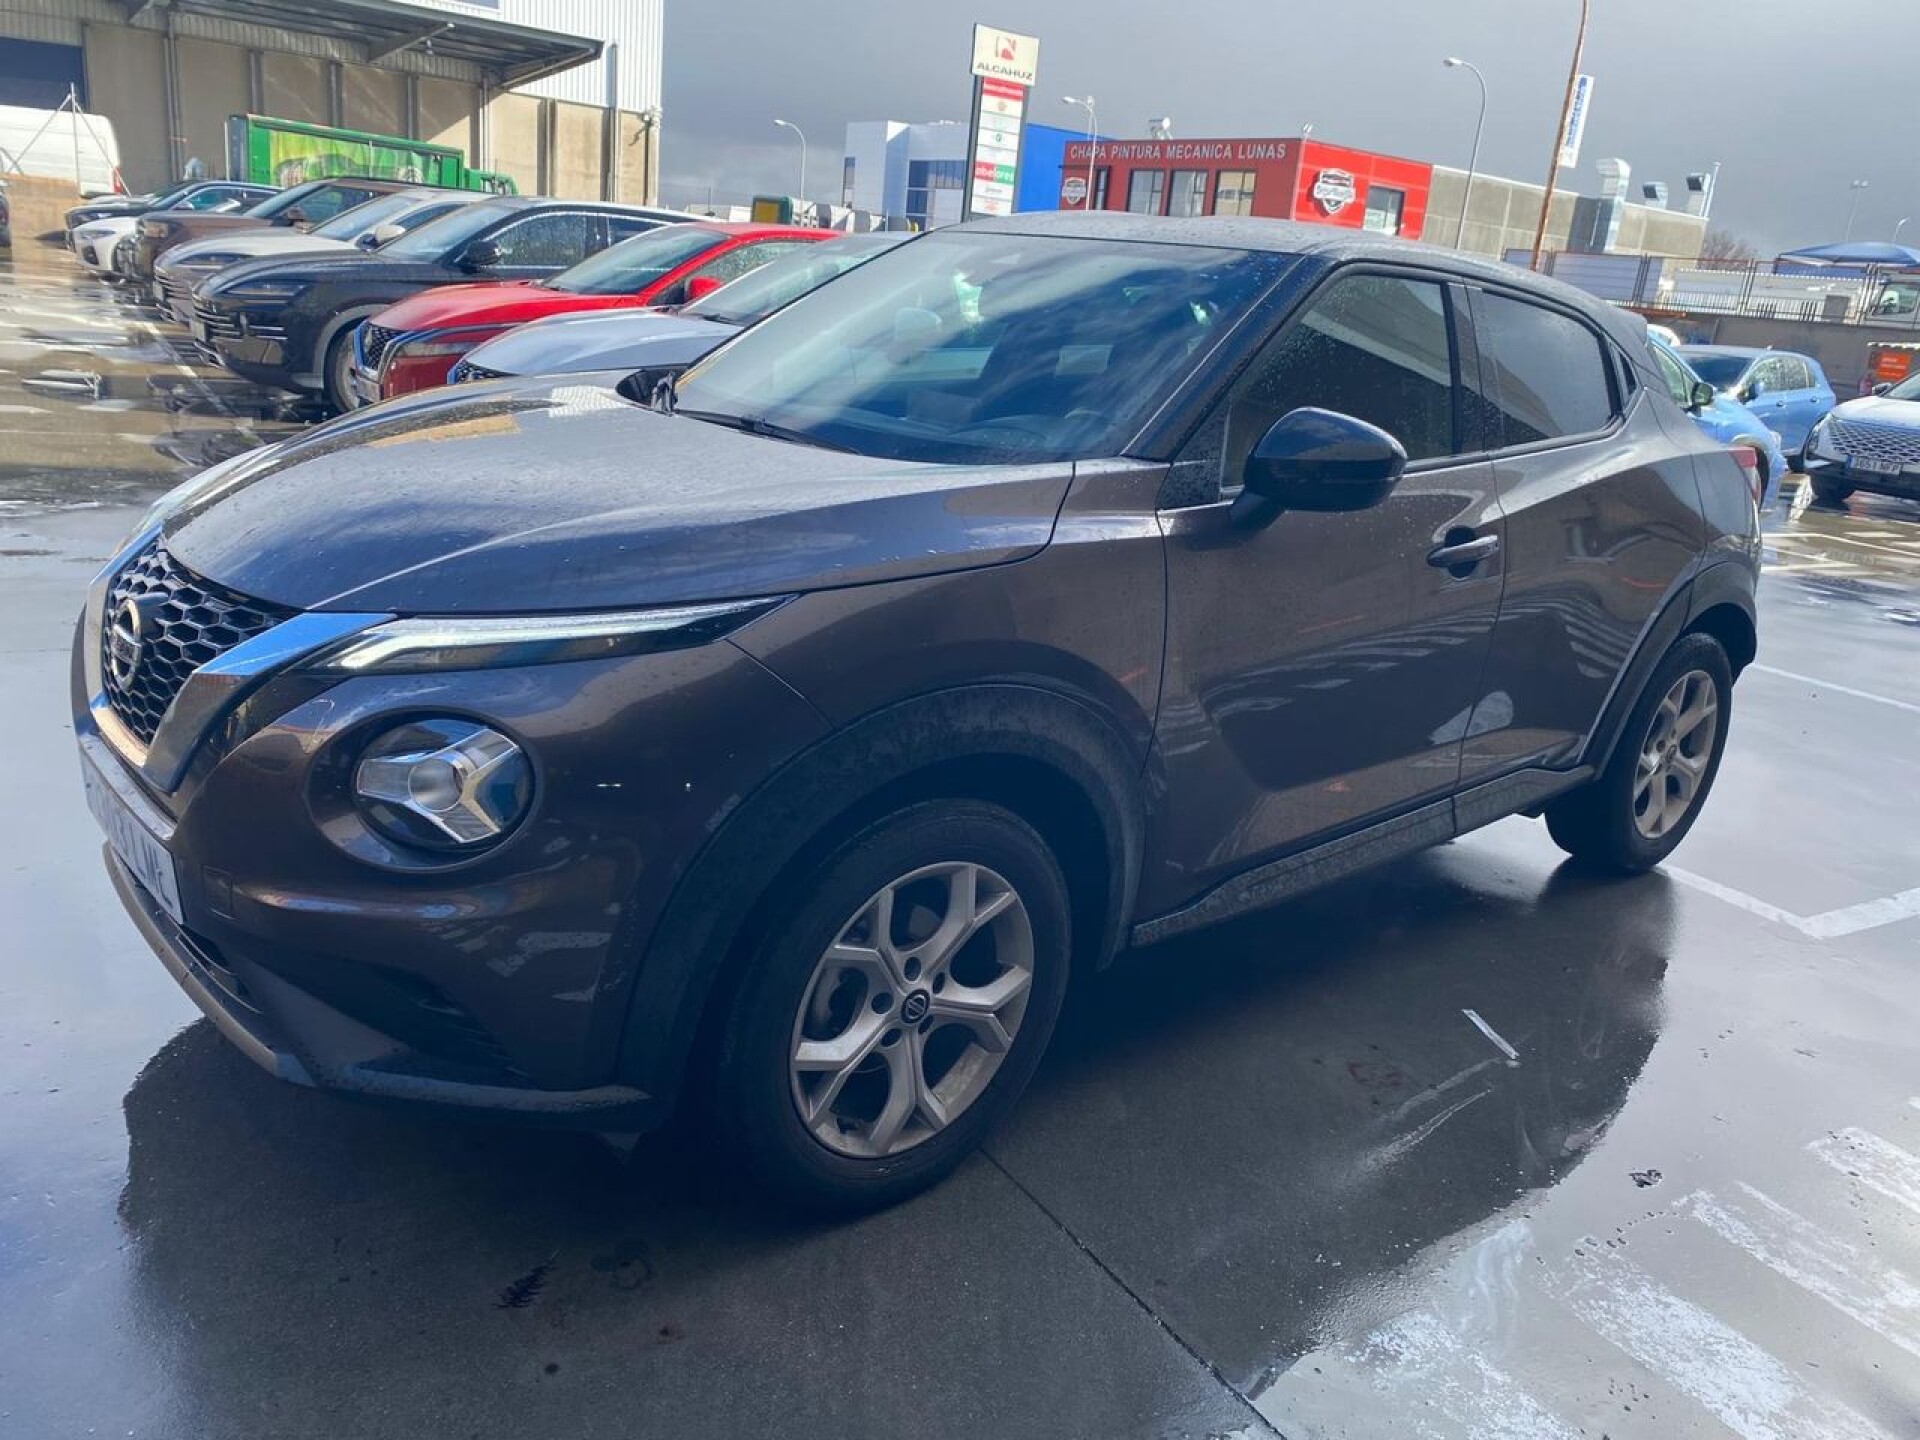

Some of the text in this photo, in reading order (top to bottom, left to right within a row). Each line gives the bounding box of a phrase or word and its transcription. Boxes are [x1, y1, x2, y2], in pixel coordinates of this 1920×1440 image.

[977, 62, 1033, 80] ALCAHUZ
[1070, 143, 1286, 159] CHAPA PINTURA MECANICA LUNAS
